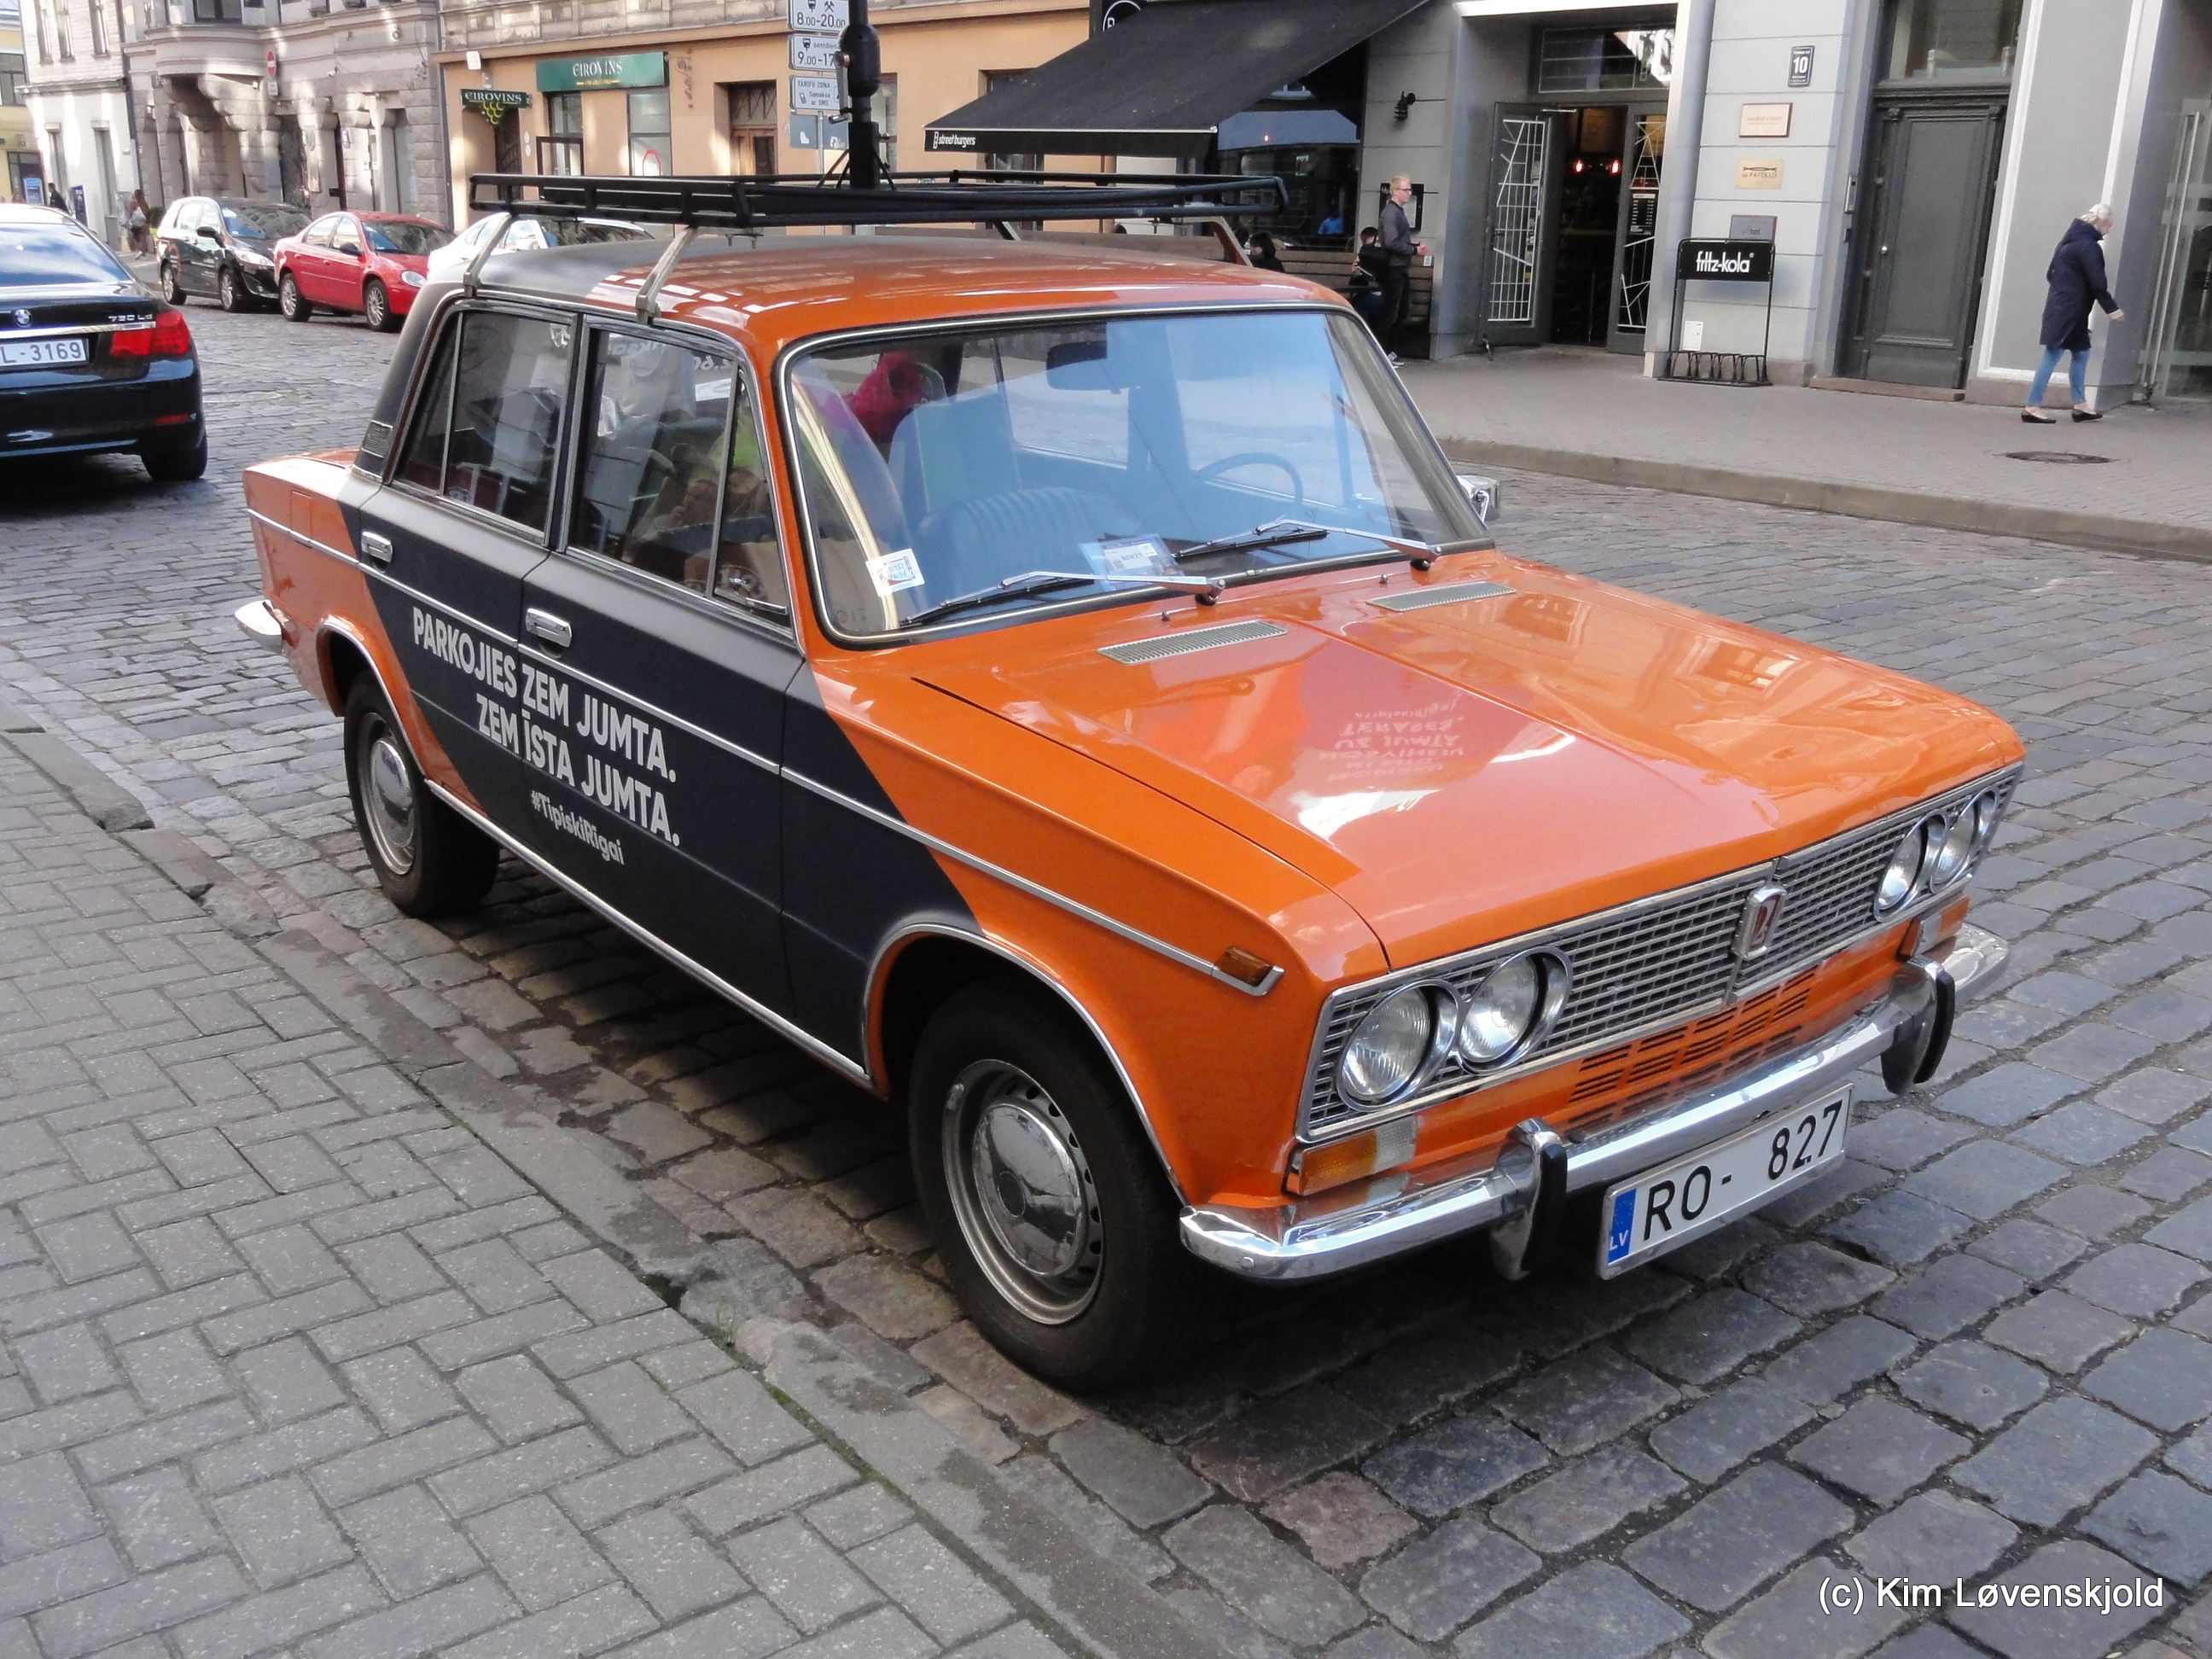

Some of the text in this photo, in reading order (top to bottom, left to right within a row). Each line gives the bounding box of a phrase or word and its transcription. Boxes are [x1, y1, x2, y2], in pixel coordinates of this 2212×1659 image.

[796, 12, 846, 28] 8.00-20.00
[573, 60, 623, 78] EIROVINS
[1793, 56, 1808, 74] 10
[465, 91, 522, 102] EIROVINS
[412, 606, 677, 783] PARKOJIES ZEM JUMTA.
[476, 693, 680, 847] ZEM ĪSTA JUMTA.
[1608, 1229, 1630, 1252] LV
